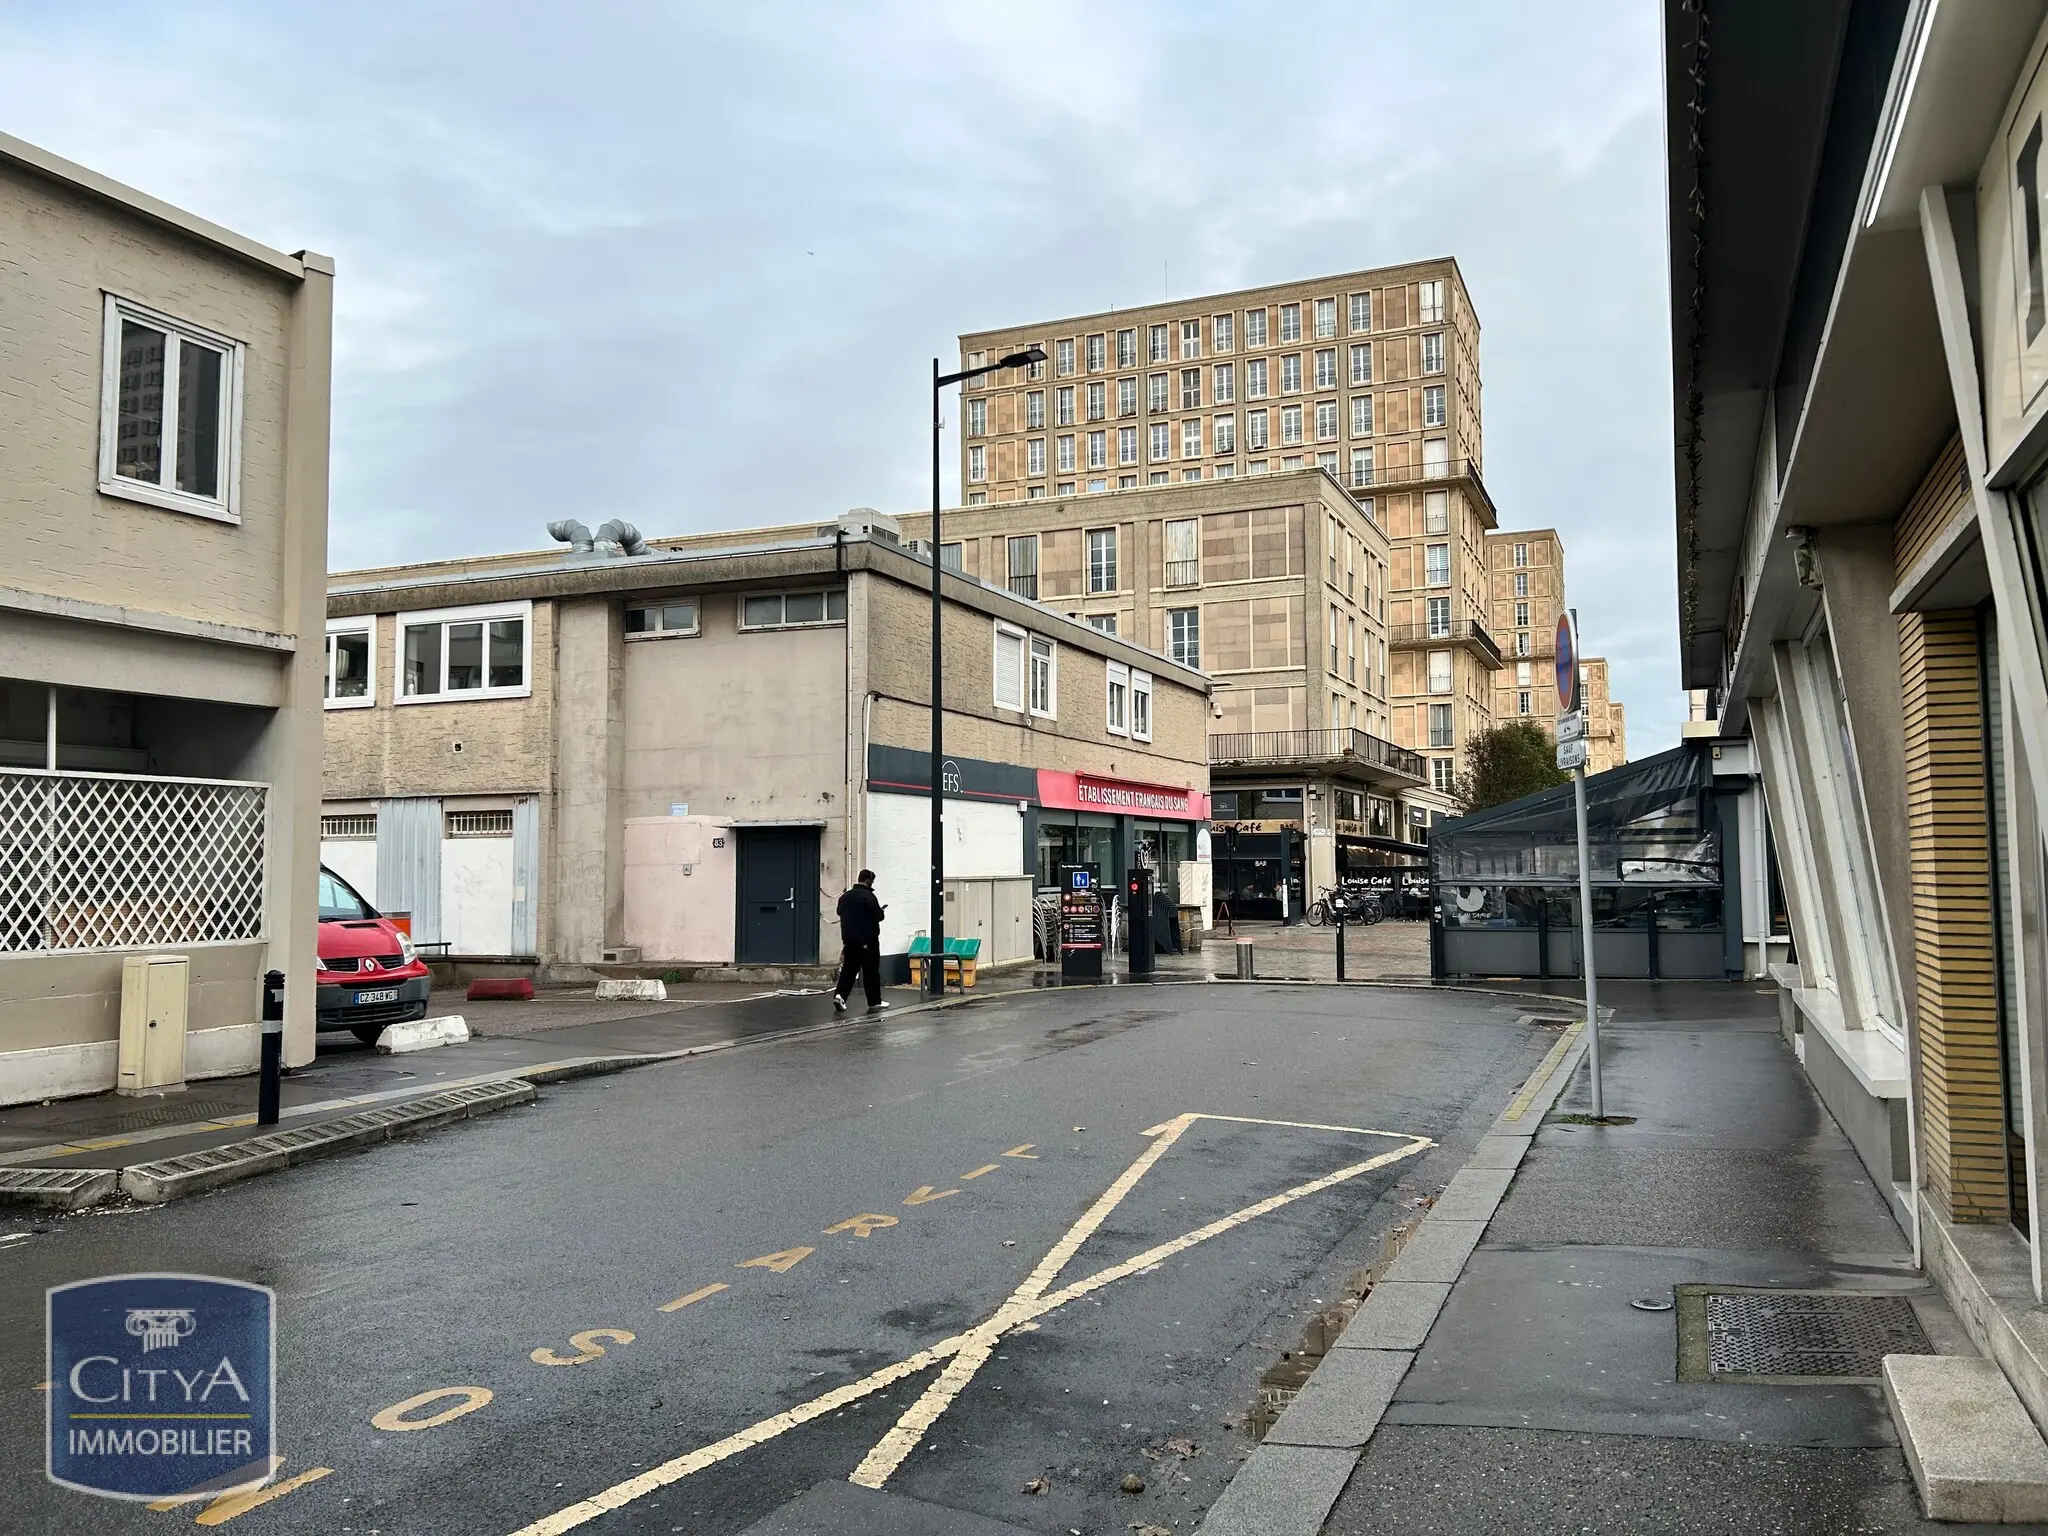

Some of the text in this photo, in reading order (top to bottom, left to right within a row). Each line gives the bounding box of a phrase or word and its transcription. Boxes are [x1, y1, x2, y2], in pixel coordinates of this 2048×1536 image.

[1563, 743, 1574, 755] SAUF
[943, 772, 959, 793] EFS
[1078, 779, 1135, 807] ÉTABLISSEMENT
[1164, 795, 1174, 811] DU
[1173, 796, 1189, 813] SANG
[1234, 822, 1262, 833] Café
[1341, 876, 1393, 886] Louise Café
[1402, 876, 1430, 886] Louise
